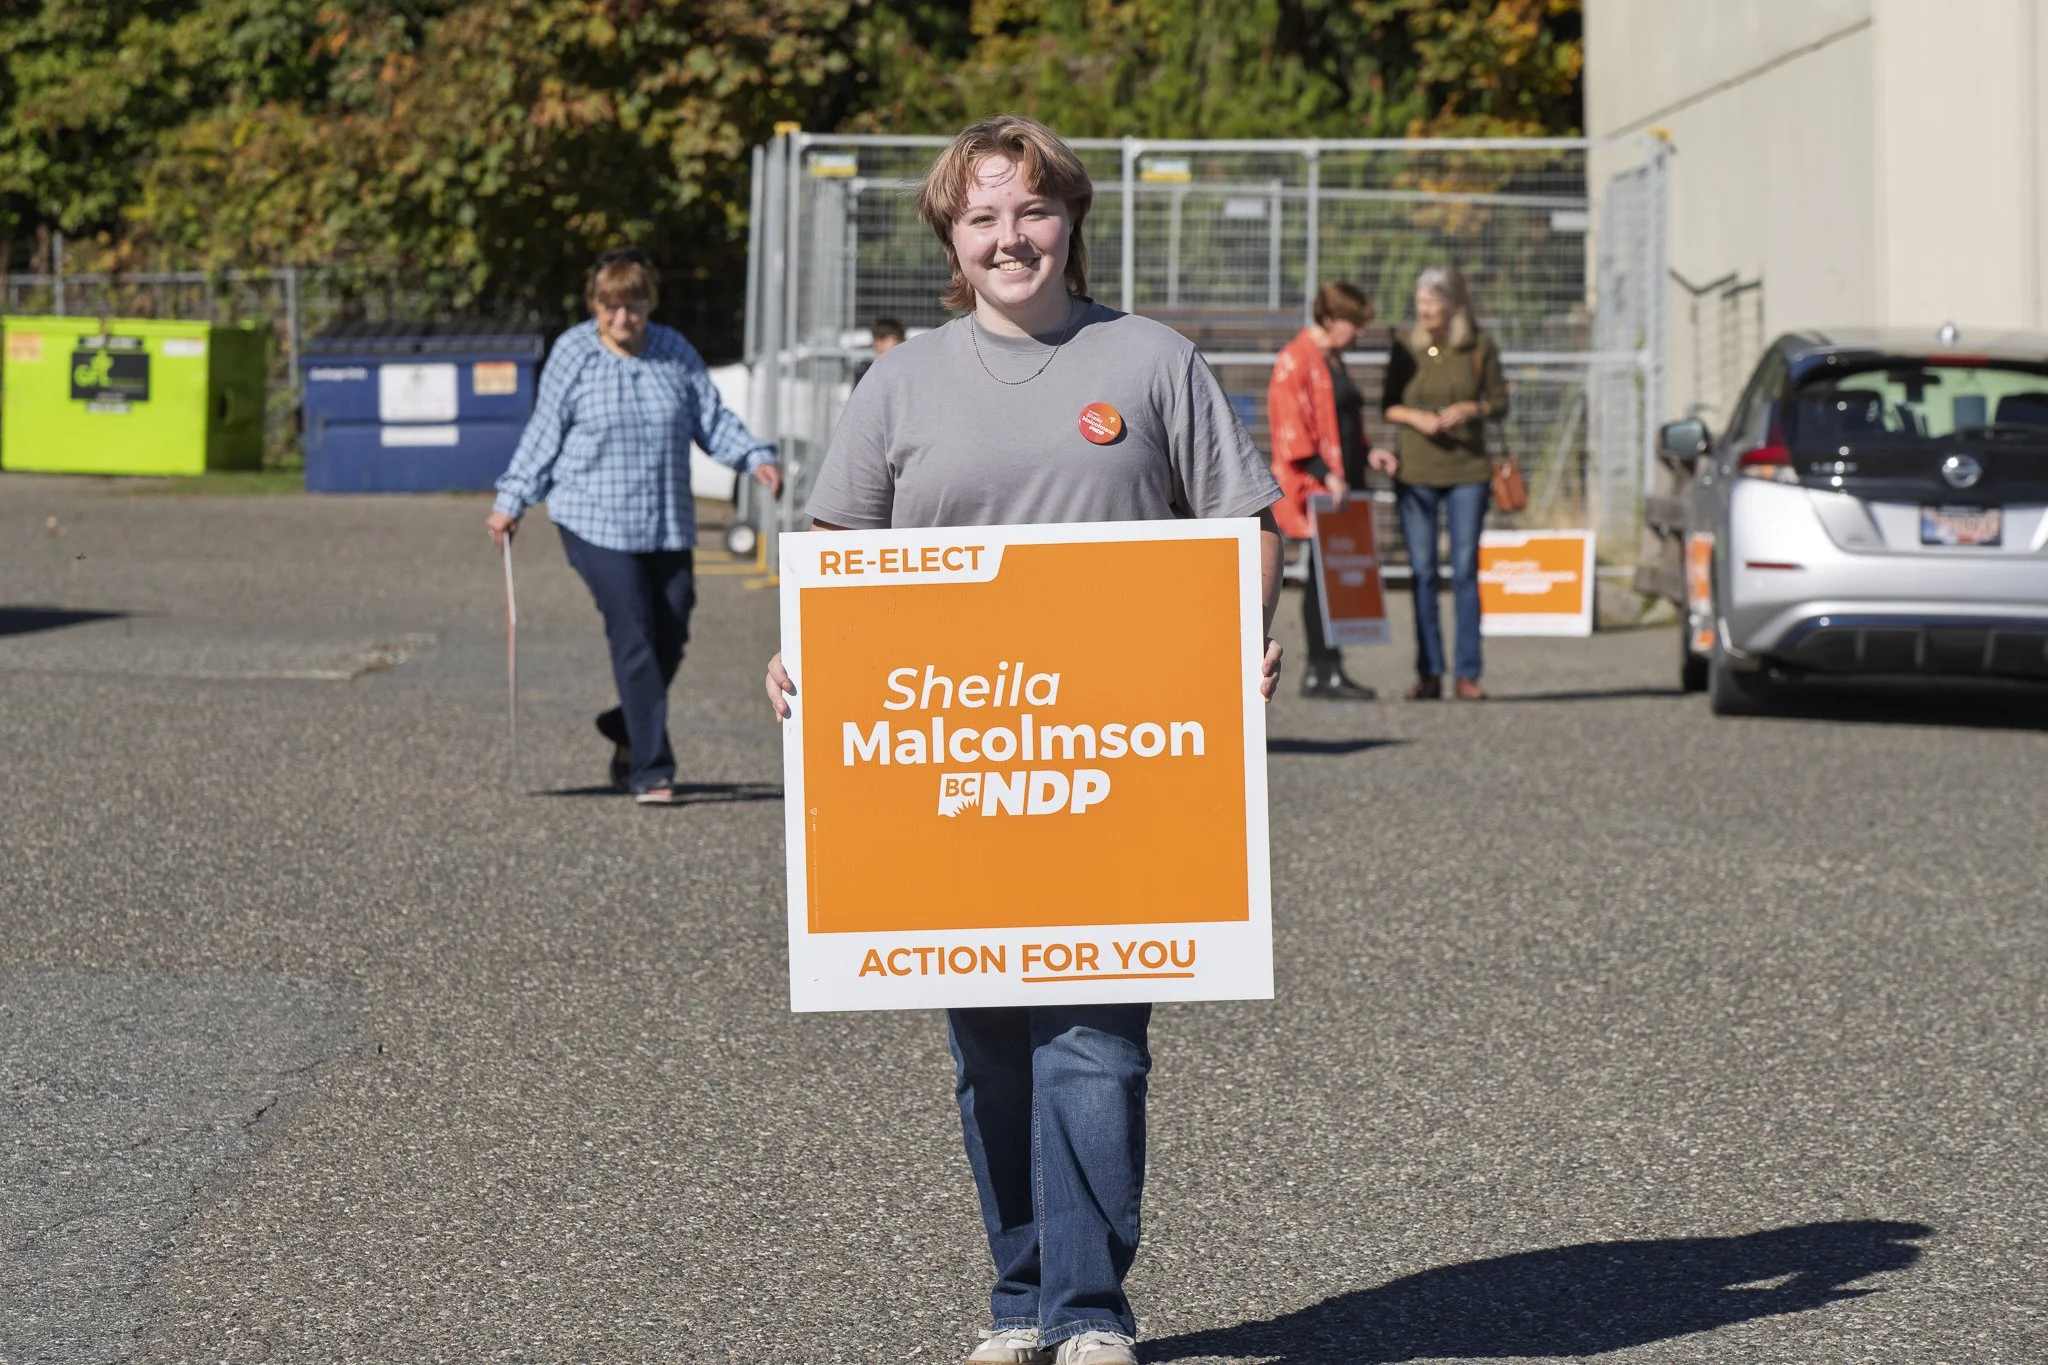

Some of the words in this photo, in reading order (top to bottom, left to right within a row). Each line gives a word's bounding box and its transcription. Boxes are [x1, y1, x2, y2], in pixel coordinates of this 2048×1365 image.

[1081, 415, 1115, 436] Malcolmson
[820, 546, 985, 576] RE-ELECT
[883, 661, 1060, 711] Sheila
[842, 713, 1205, 767] Malcolmson
[945, 778, 976, 798] BC
[982, 769, 1111, 817] NDP
[858, 946, 1007, 977] ACTION
[1021, 943, 1099, 972] FOR
[1112, 940, 1196, 970] YOU
